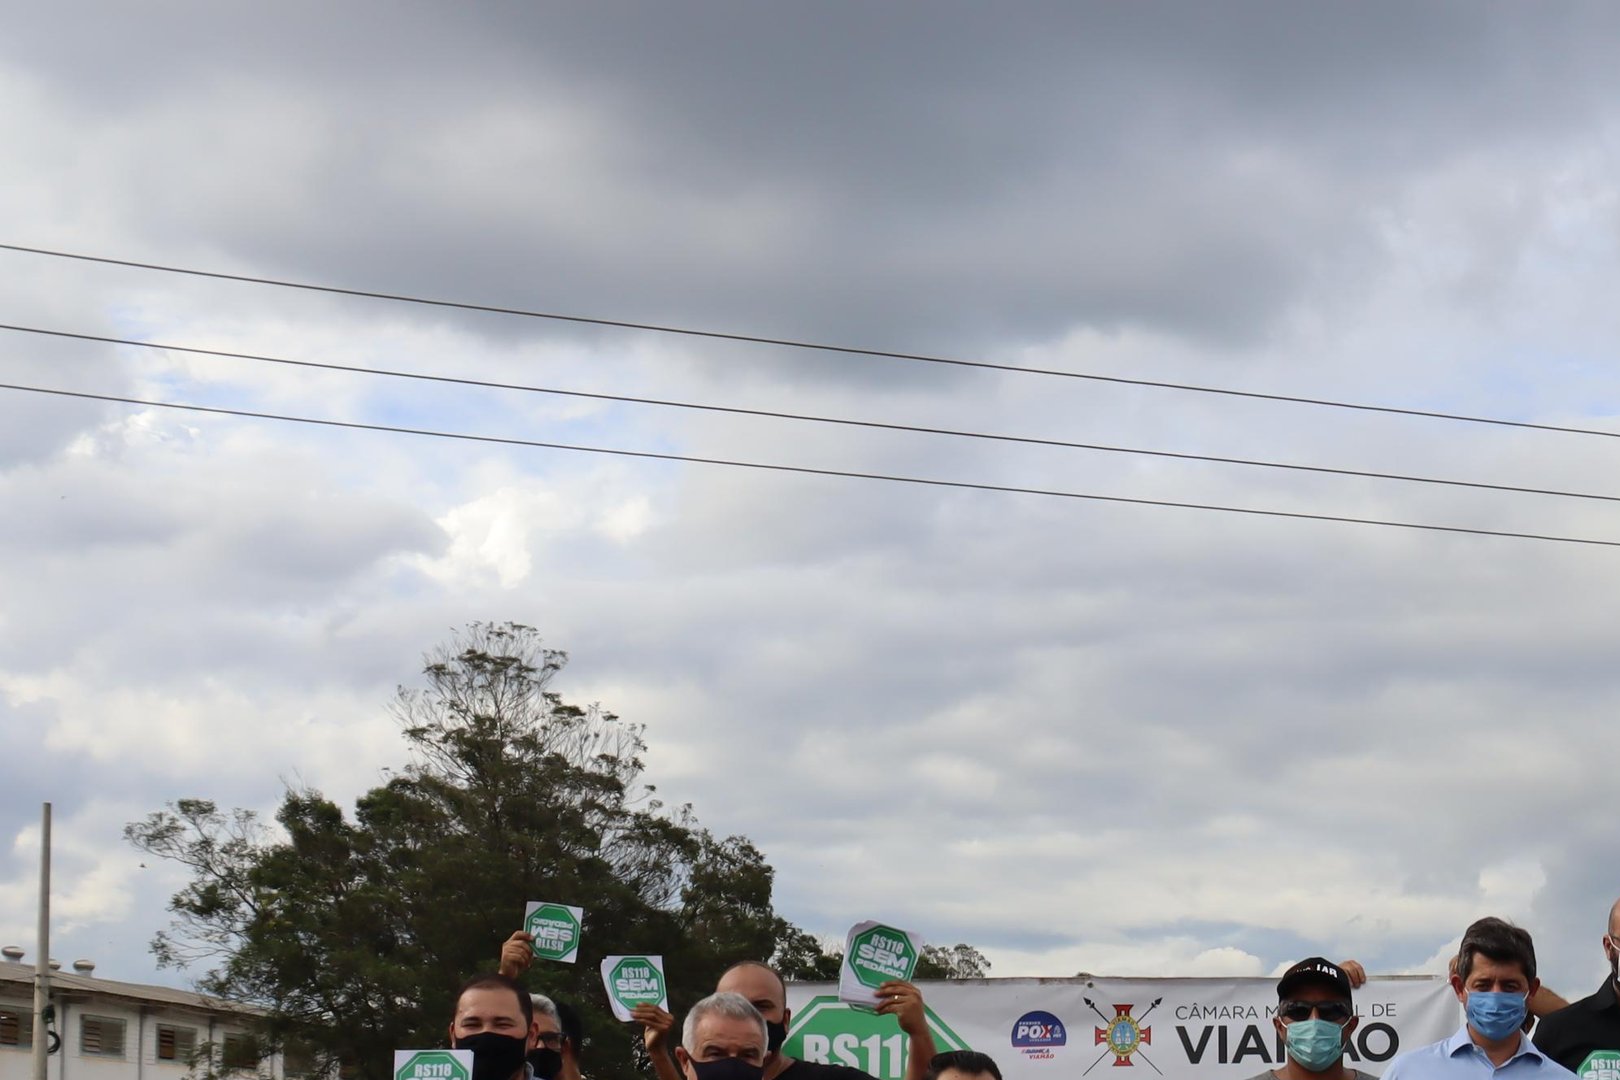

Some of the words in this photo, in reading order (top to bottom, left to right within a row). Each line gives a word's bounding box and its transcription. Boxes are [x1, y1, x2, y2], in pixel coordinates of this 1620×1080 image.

[530, 925, 573, 942] SEM
[535, 937, 565, 952] RS118
[870, 933, 905, 954] RS118
[857, 943, 910, 971] SEM
[621, 966, 650, 979] RS118
[855, 957, 905, 979] PEDÁGIO
[615, 978, 659, 991] SEM
[1175, 1002, 1256, 1021] CÂMARA
[1372, 1003, 1397, 1017] DE
[803, 1033, 910, 1078] RS11
[414, 1063, 452, 1077] RS118
